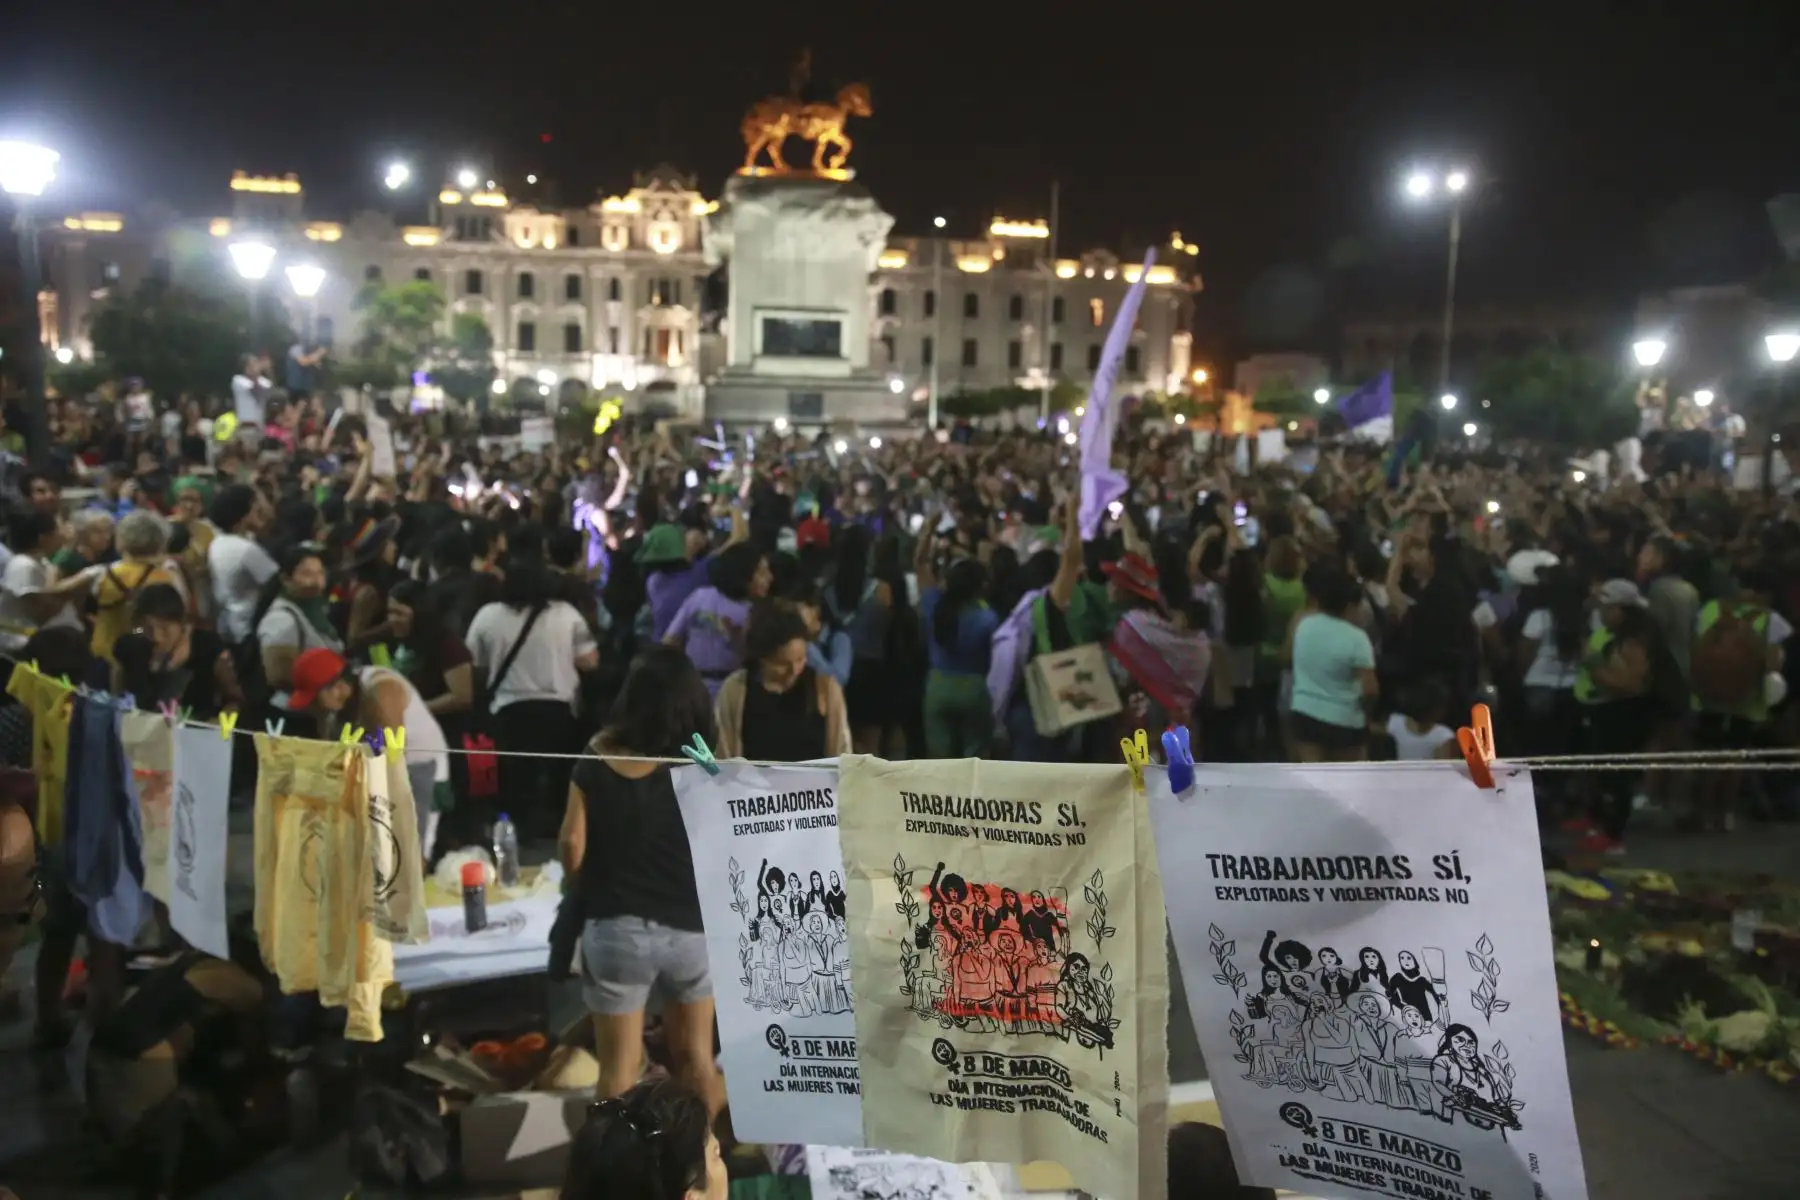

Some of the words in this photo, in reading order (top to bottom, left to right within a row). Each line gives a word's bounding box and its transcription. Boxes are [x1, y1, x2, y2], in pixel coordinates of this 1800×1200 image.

[727, 788, 834, 818] TRABAJADORAS
[900, 791, 1042, 825] TRABAJADORAS
[733, 819, 785, 836] EXPLOTADAS
[786, 818, 793, 831] Y
[794, 814, 839, 830] VIOLENTAD
[905, 819, 970, 838] EXPLOTADAS
[971, 826, 980, 839] Y
[983, 827, 1062, 846] VIOLENTADAS
[1065, 832, 1086, 846] NO
[1205, 853, 1412, 881] TRABAJADORAS
[1432, 849, 1471, 884] SÍ,
[1215, 886, 1310, 902] EXPLOTADAS
[1313, 887, 1325, 902] Y
[1330, 886, 1440, 902] VIOLENTADAS
[1446, 887, 1469, 904] NO
[791, 1040, 801, 1056] 8
[804, 1040, 823, 1056] DE
[780, 1062, 798, 1077] DÍA
[963, 1055, 976, 1073] 8
[982, 1056, 1005, 1076] DE
[1009, 1060, 1072, 1087] MARZO
[763, 1080, 785, 1092] LAS
[787, 1080, 834, 1094] MUJERES
[973, 1081, 1073, 1108] INTERNACIONAL
[1075, 1100, 1090, 1117] DE
[929, 1092, 953, 1107] LAS
[955, 1094, 1015, 1113] MUJERES
[1019, 1098, 1108, 1144] TRABAJADORAS
[1321, 1120, 1335, 1140] 8
[1344, 1125, 1373, 1147] DE
[1379, 1133, 1463, 1173] MARZO
[1278, 1154, 1310, 1170] LAS
[1314, 1159, 1386, 1188] MUJERES
[1335, 1148, 1463, 1196] INTERNACIONAL
